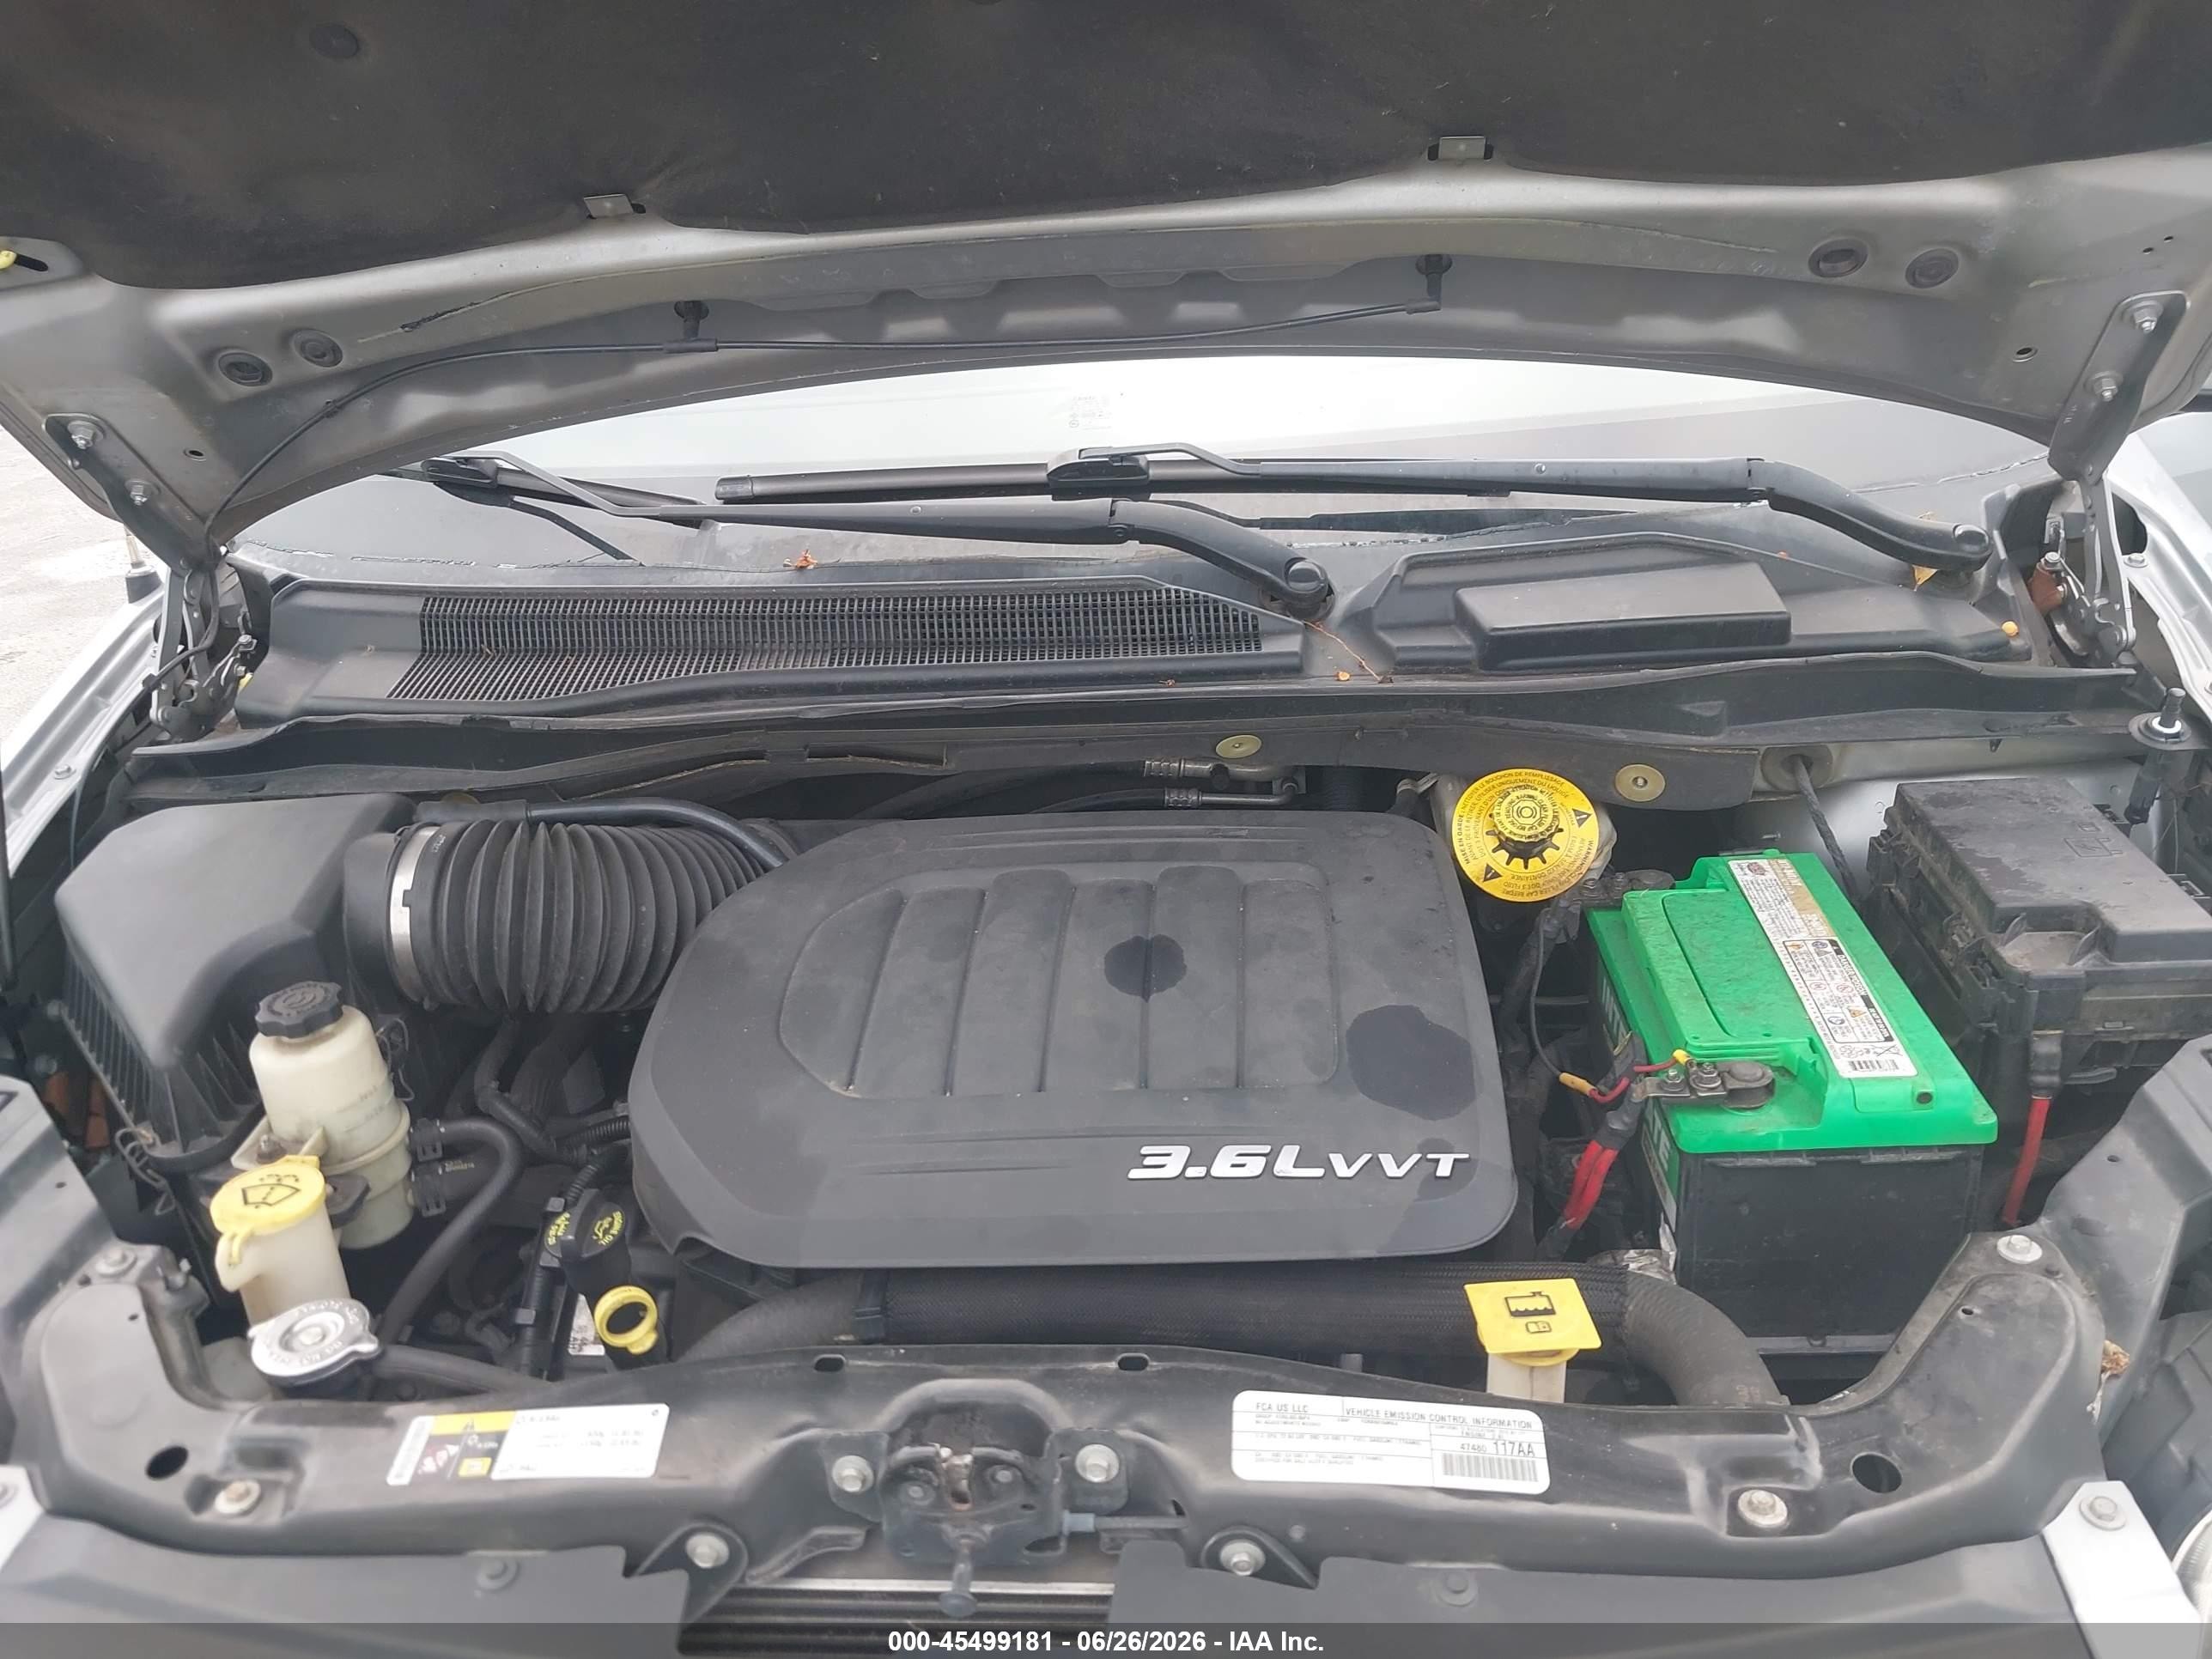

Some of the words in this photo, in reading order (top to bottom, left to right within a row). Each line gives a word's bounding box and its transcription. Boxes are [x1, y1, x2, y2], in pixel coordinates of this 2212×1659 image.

[599, 1234, 614, 1246] OIL
[1256, 1402, 1273, 1411] FCA
[1277, 1403, 1289, 1412] US
[1292, 1404, 1309, 1413] LLC
[1346, 1407, 1379, 1417] VEHICLE
[1384, 1411, 1426, 1420] EMISSION
[1430, 1413, 1468, 1424] CONTROL
[1472, 1417, 1533, 1429] INFORMATION
[1493, 1440, 1535, 1457] 117AA
